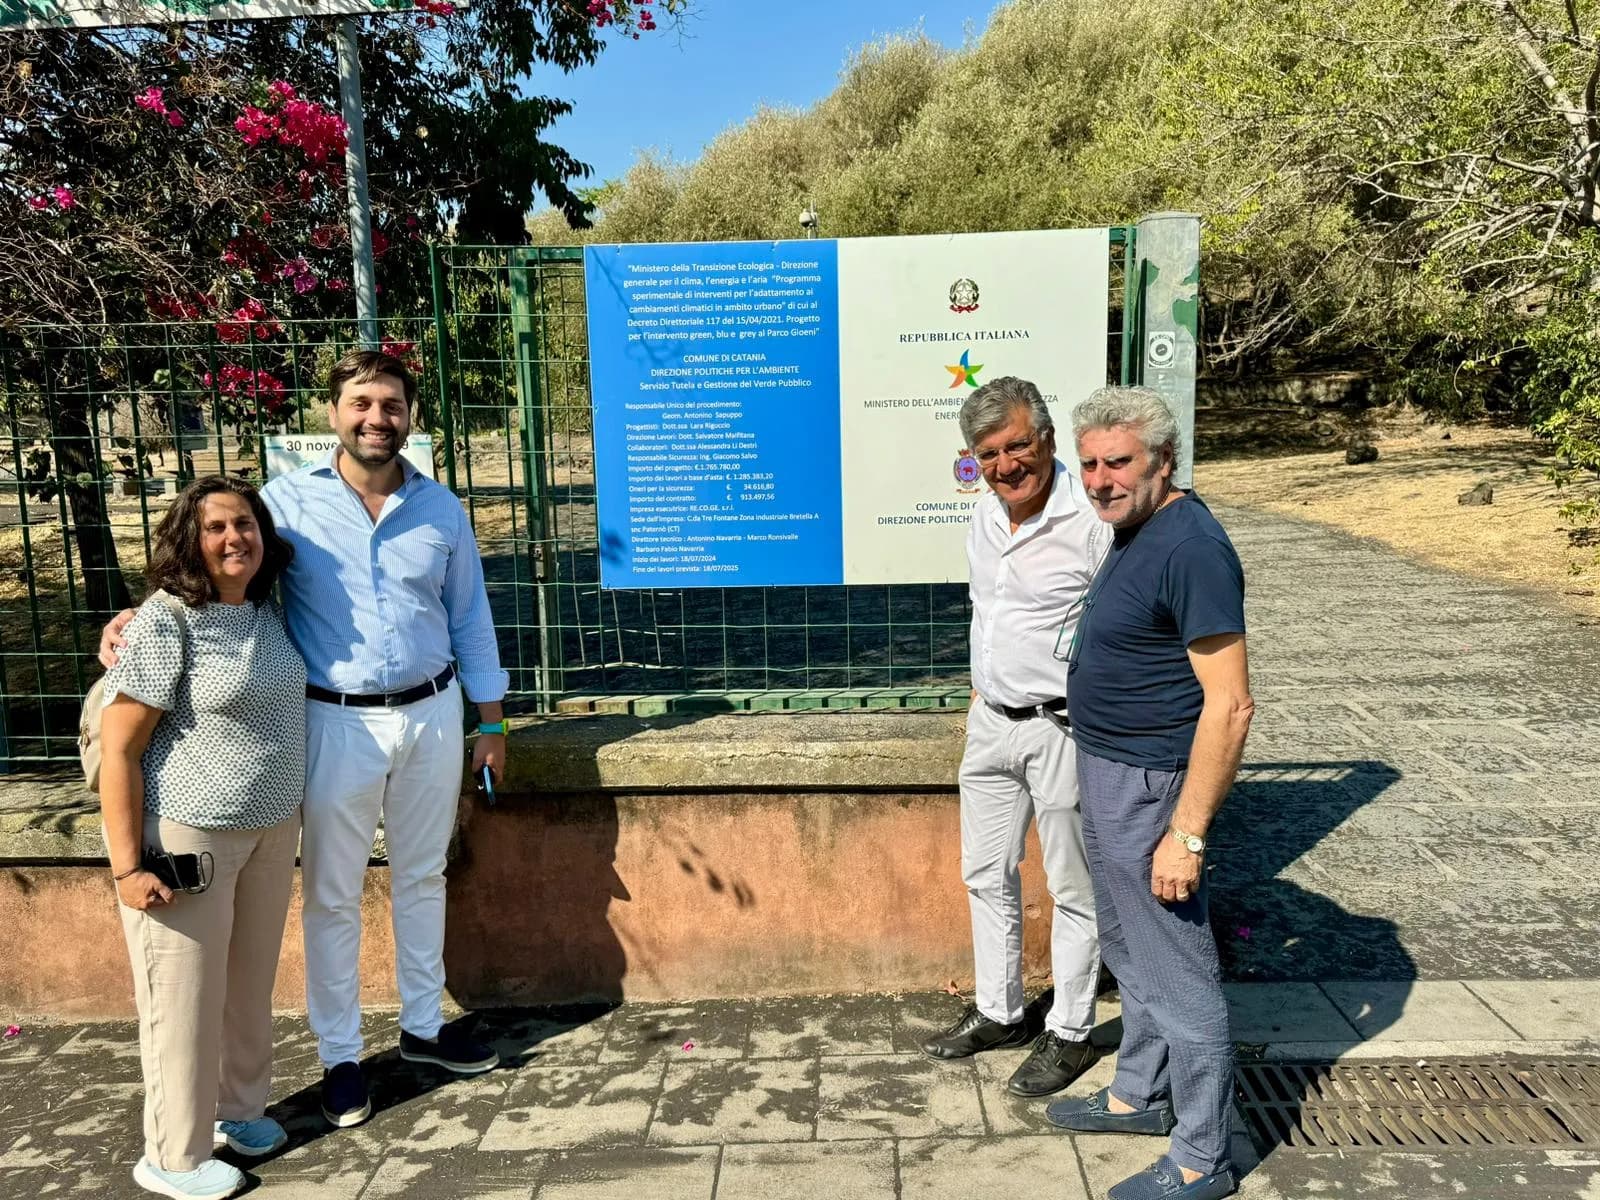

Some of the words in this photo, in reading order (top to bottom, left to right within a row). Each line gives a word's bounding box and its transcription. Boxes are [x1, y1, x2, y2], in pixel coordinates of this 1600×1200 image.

[671, 264, 691, 272] della
[693, 263, 736, 272] Transizione
[738, 262, 775, 272] Ecologica
[781, 261, 819, 270] Direzione
[623, 278, 657, 288] generale
[659, 279, 672, 287] per
[674, 277, 679, 285] il
[681, 277, 704, 286] clima,
[632, 290, 683, 301] sperimentale
[685, 290, 692, 298] di
[694, 289, 732, 298] interventi
[734, 291, 747, 299] per
[806, 288, 814, 296] ai
[629, 304, 680, 313] cambiamenti
[681, 304, 713, 312] climatici
[715, 303, 722, 311] in
[724, 303, 752, 311] ambito
[787, 302, 795, 310] di
[797, 302, 808, 310] cui
[810, 302, 818, 310] al
[627, 318, 658, 326] Decreto
[660, 317, 704, 326] Direttoriale
[706, 317, 720, 325] 117
[722, 316, 734, 325] del
[736, 315, 784, 325] 15/04/2021.
[786, 315, 821, 325] Progetto
[628, 334, 641, 342] per
[690, 333, 714, 341] green,
[716, 331, 729, 339] blu
[739, 332, 756, 340] grey
[758, 330, 765, 338] al
[767, 330, 789, 338] Parco
[899, 332, 972, 343] REPUBBLICA
[974, 329, 1030, 341] ITALIANA
[683, 355, 720, 363] COMUNE
[721, 354, 730, 362] DI
[731, 354, 766, 362] CATANIA
[651, 368, 692, 376] DIREZIONE
[694, 368, 734, 376] POLITICHE
[736, 367, 751, 375] PER
[639, 382, 670, 390] Servizio
[672, 381, 695, 389] Tutela
[704, 380, 738, 389] Gestione
[739, 380, 752, 388] del
[754, 380, 777, 388] Verde
[778, 379, 812, 388] Pubblico
[864, 400, 910, 408] MINISTERO
[912, 398, 965, 407] DELL'AMBIEN
[286, 440, 302, 451] 30
[306, 441, 338, 451] nove
[916, 502, 958, 511] COMUNE
[960, 502, 970, 511] DI
[878, 516, 927, 525] DIREZIONE
